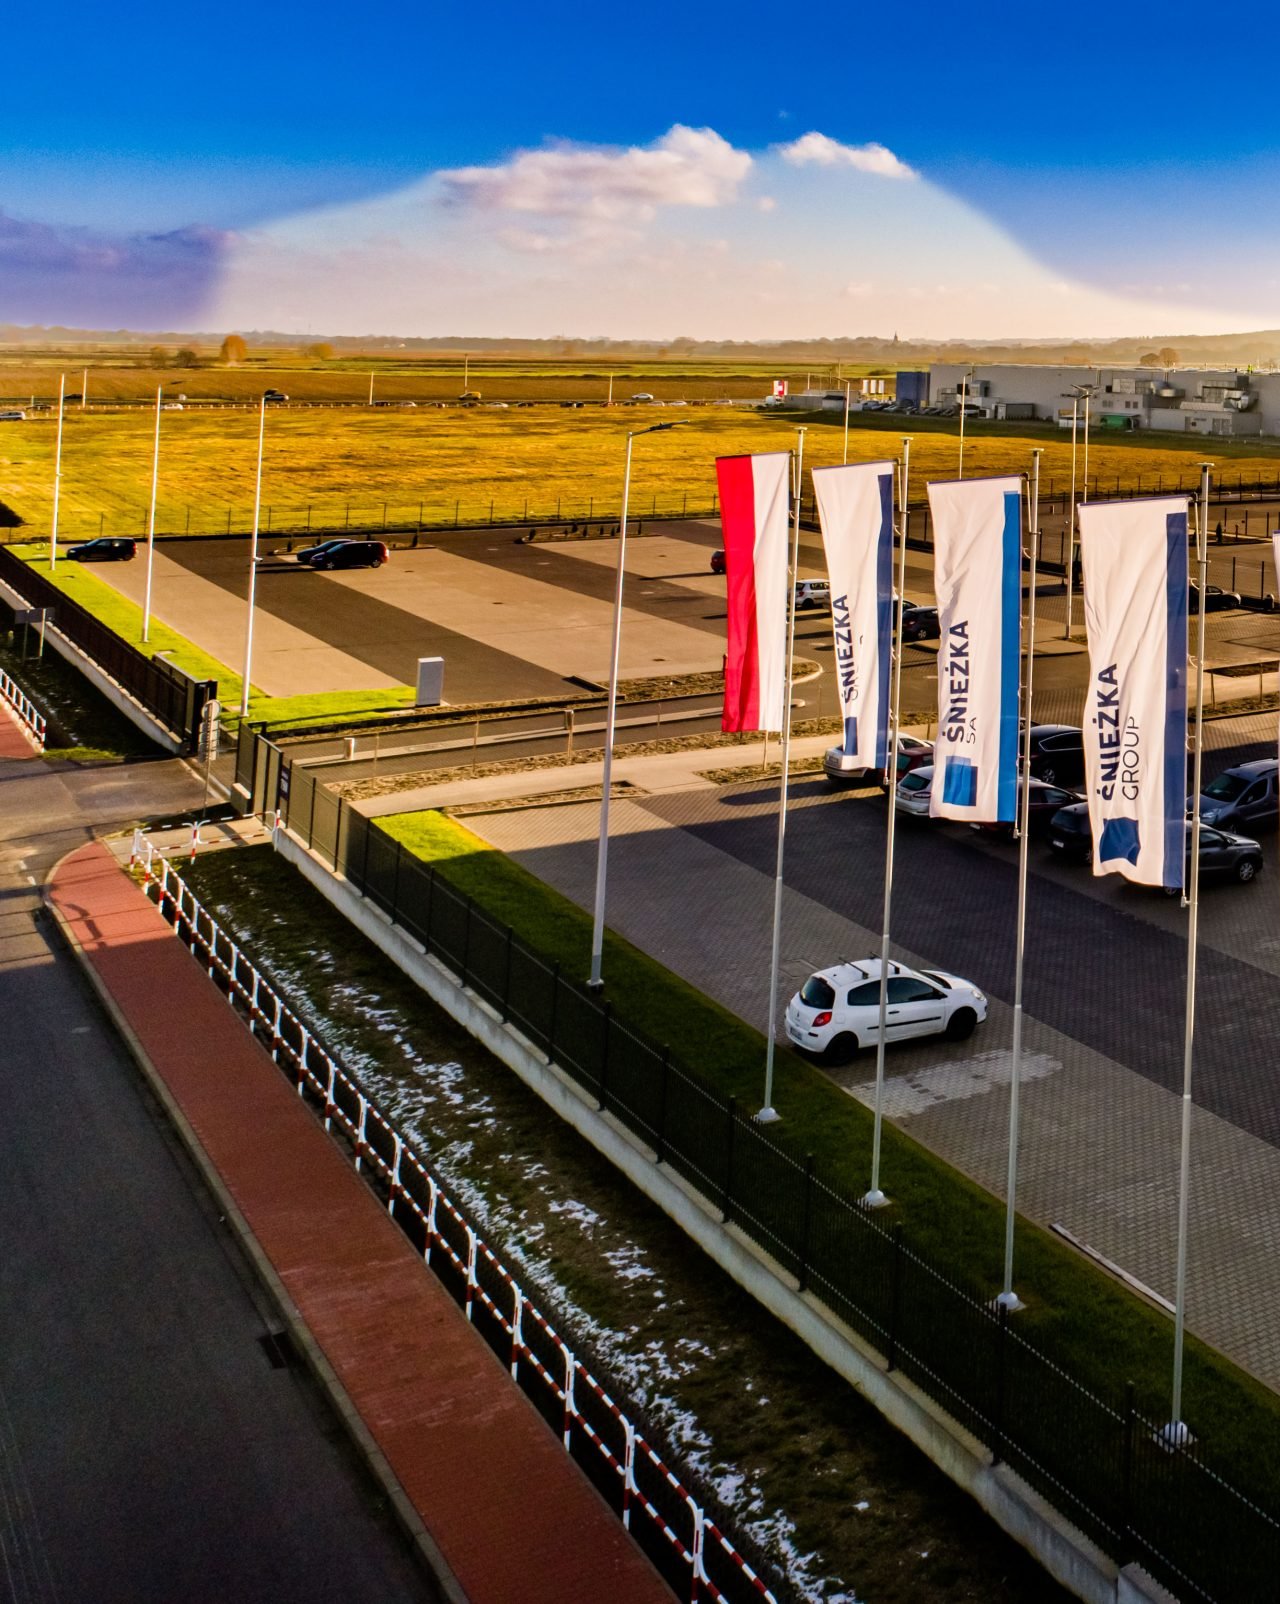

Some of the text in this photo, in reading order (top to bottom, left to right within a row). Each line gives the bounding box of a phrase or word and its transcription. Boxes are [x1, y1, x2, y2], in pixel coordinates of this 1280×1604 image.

[941, 620, 970, 743] ŚNIEŻKA
[966, 716, 977, 744] SA
[1092, 663, 1121, 801] ŚNIEŻKA
[1121, 715, 1140, 801] GROUP
